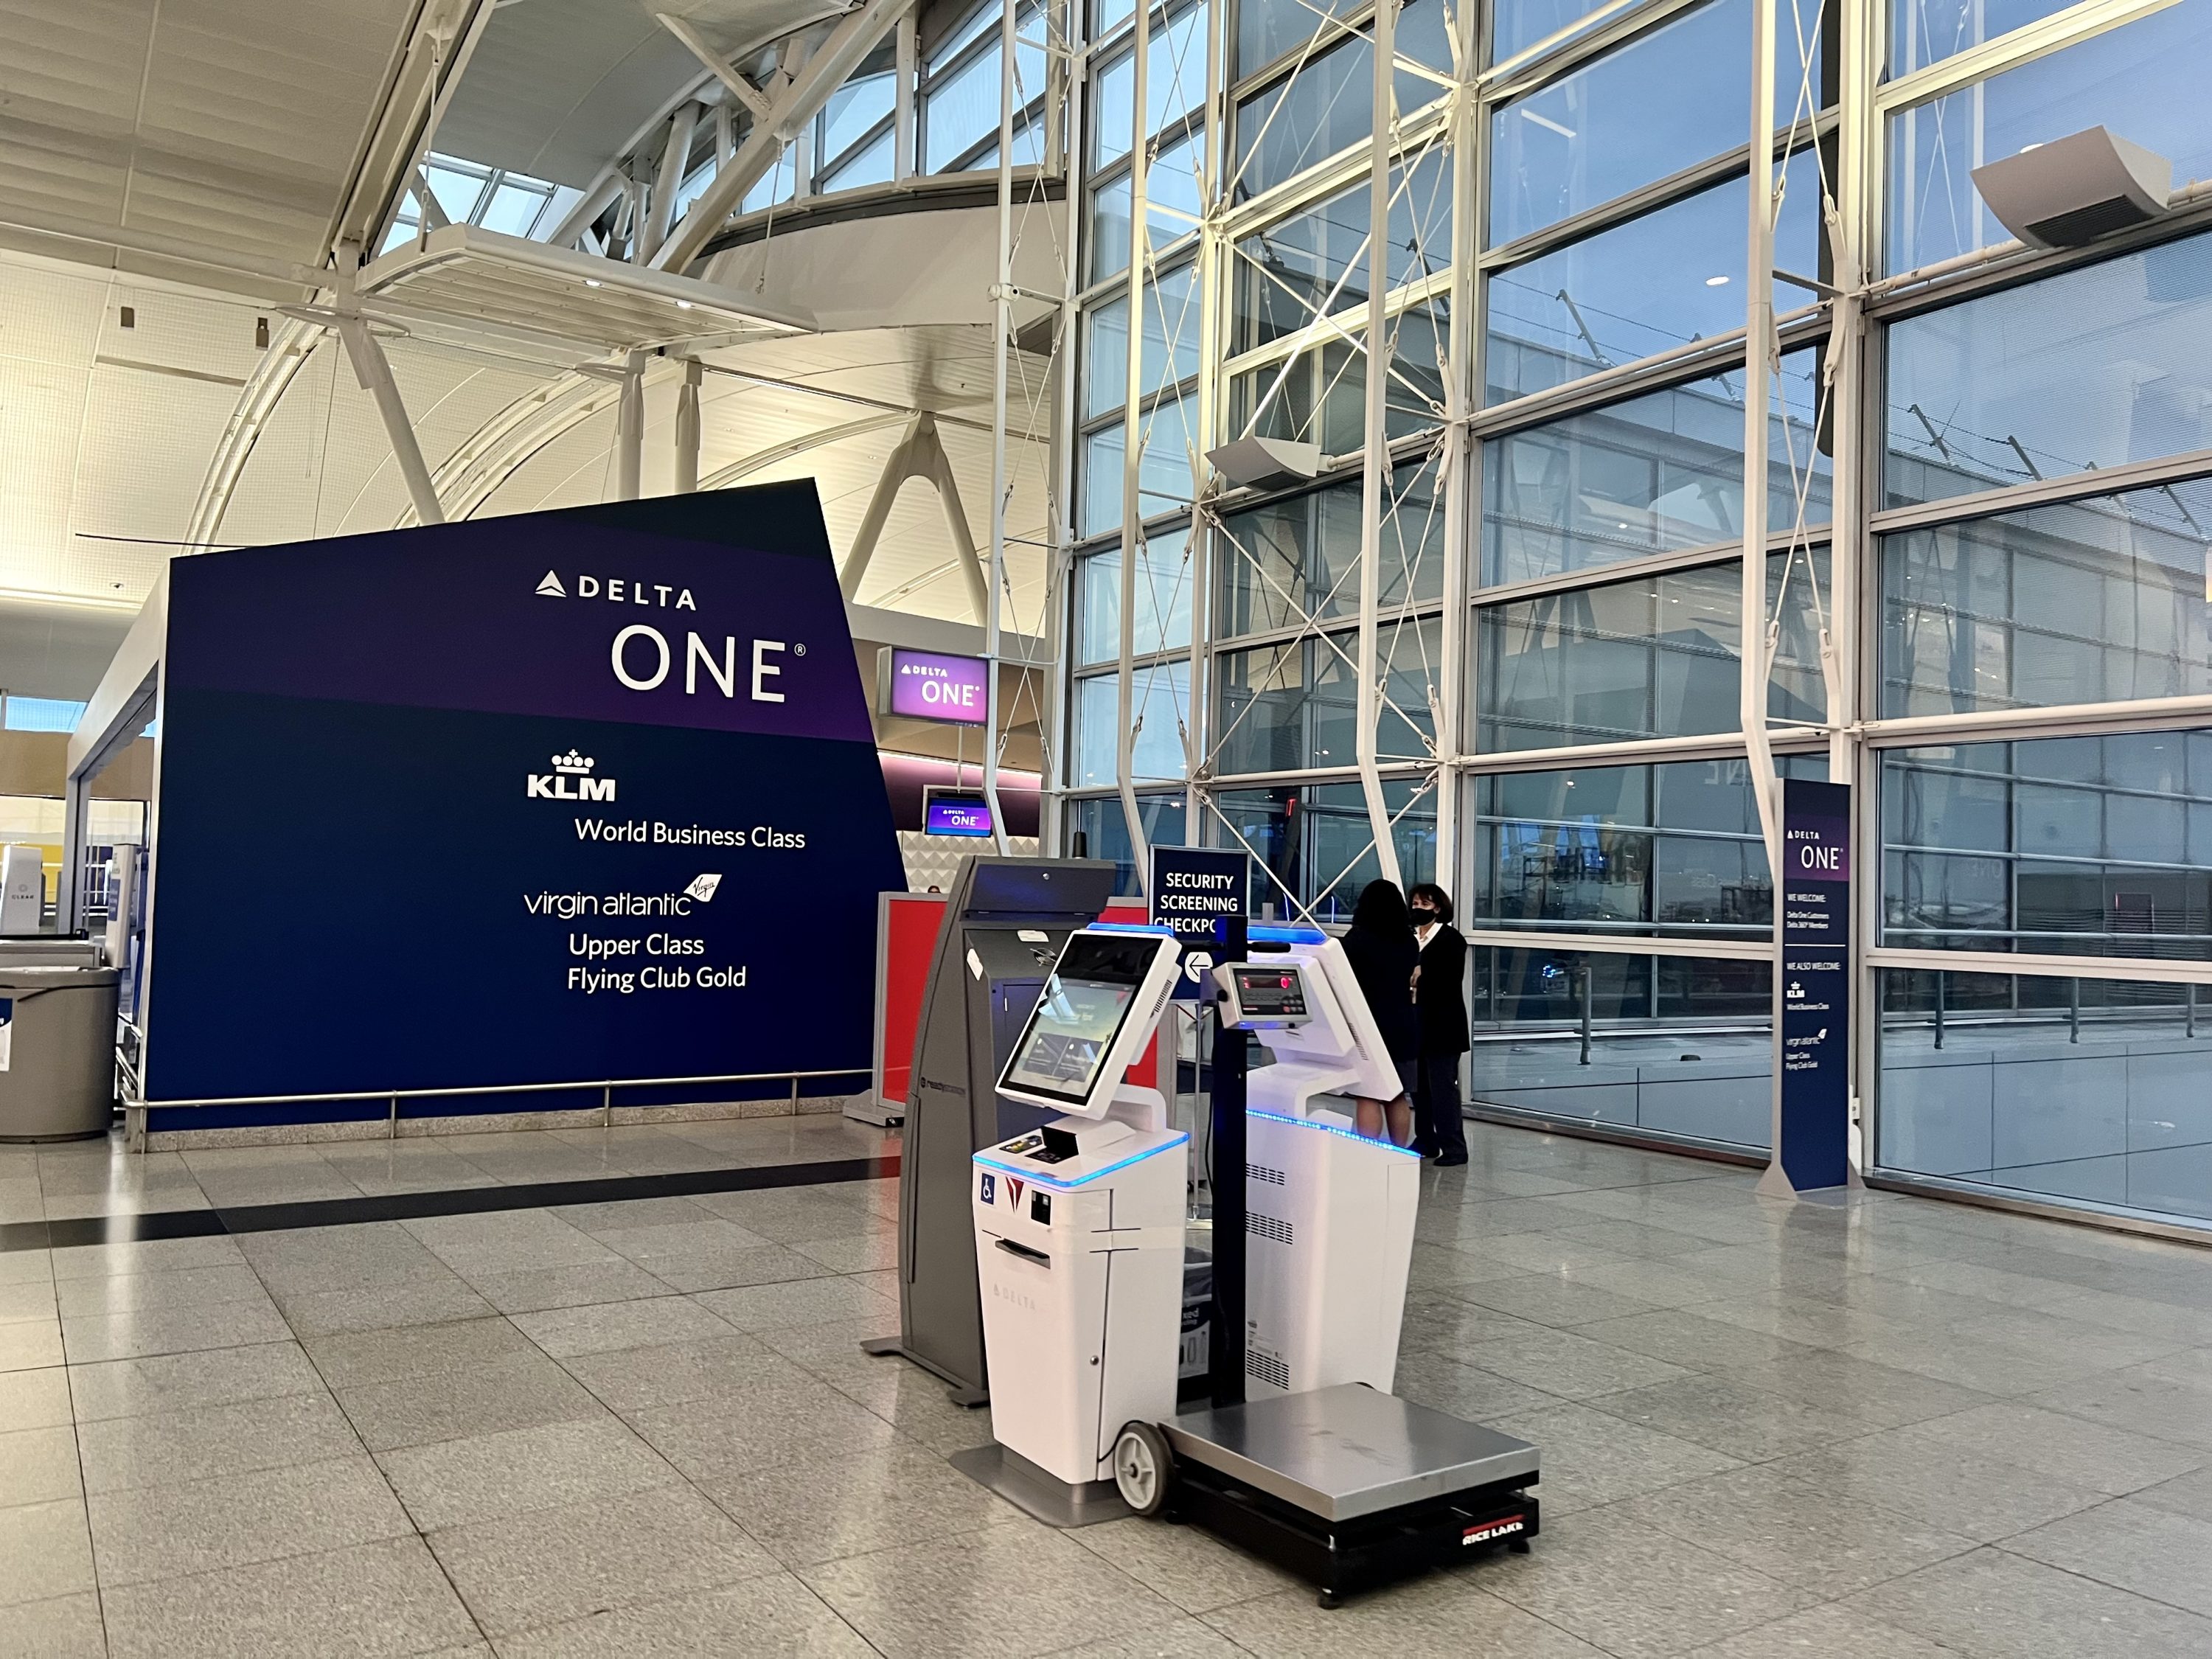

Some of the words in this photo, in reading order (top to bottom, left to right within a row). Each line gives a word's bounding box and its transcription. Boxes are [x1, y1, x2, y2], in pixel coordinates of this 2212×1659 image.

[578, 574, 697, 611] DELTA
[913, 665, 947, 678] DELTA
[527, 774, 616, 801] KLM
[574, 818, 647, 843] World
[653, 821, 745, 846] Business
[751, 827, 806, 849] Class
[1795, 830, 1820, 840] DELTA
[1166, 872, 1234, 890] SECURITY
[524, 891, 598, 919] virgin
[602, 891, 692, 916] atlantic
[1160, 894, 1238, 912] SCREENING
[569, 933, 641, 960] Upper
[646, 933, 704, 955] Class
[568, 967, 635, 994] Flying
[640, 967, 691, 988] Club
[696, 965, 746, 988] Gold
[1461, 1530, 1490, 1545] RICE
[1491, 1522, 1524, 1537] LAKE
